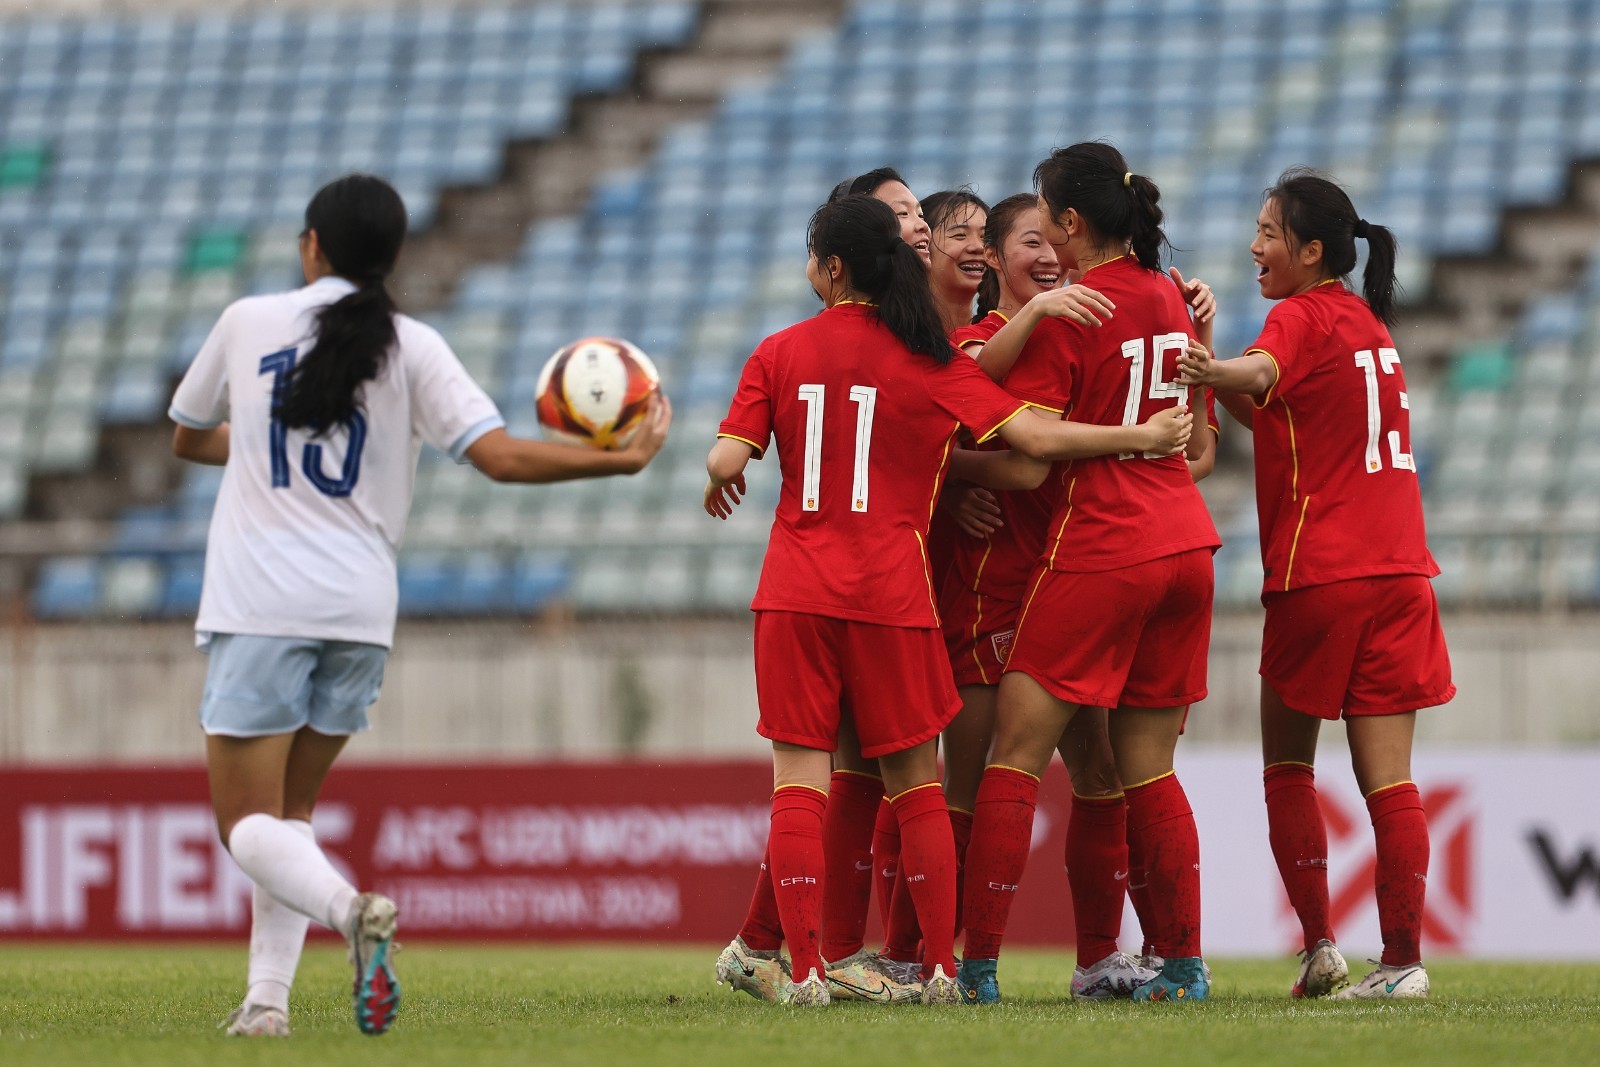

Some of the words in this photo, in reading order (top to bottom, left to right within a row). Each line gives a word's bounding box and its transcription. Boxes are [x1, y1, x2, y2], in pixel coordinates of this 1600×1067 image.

[797, 383, 878, 513] 11
[1354, 347, 1417, 474] 13
[781, 877, 816, 887] CFA
